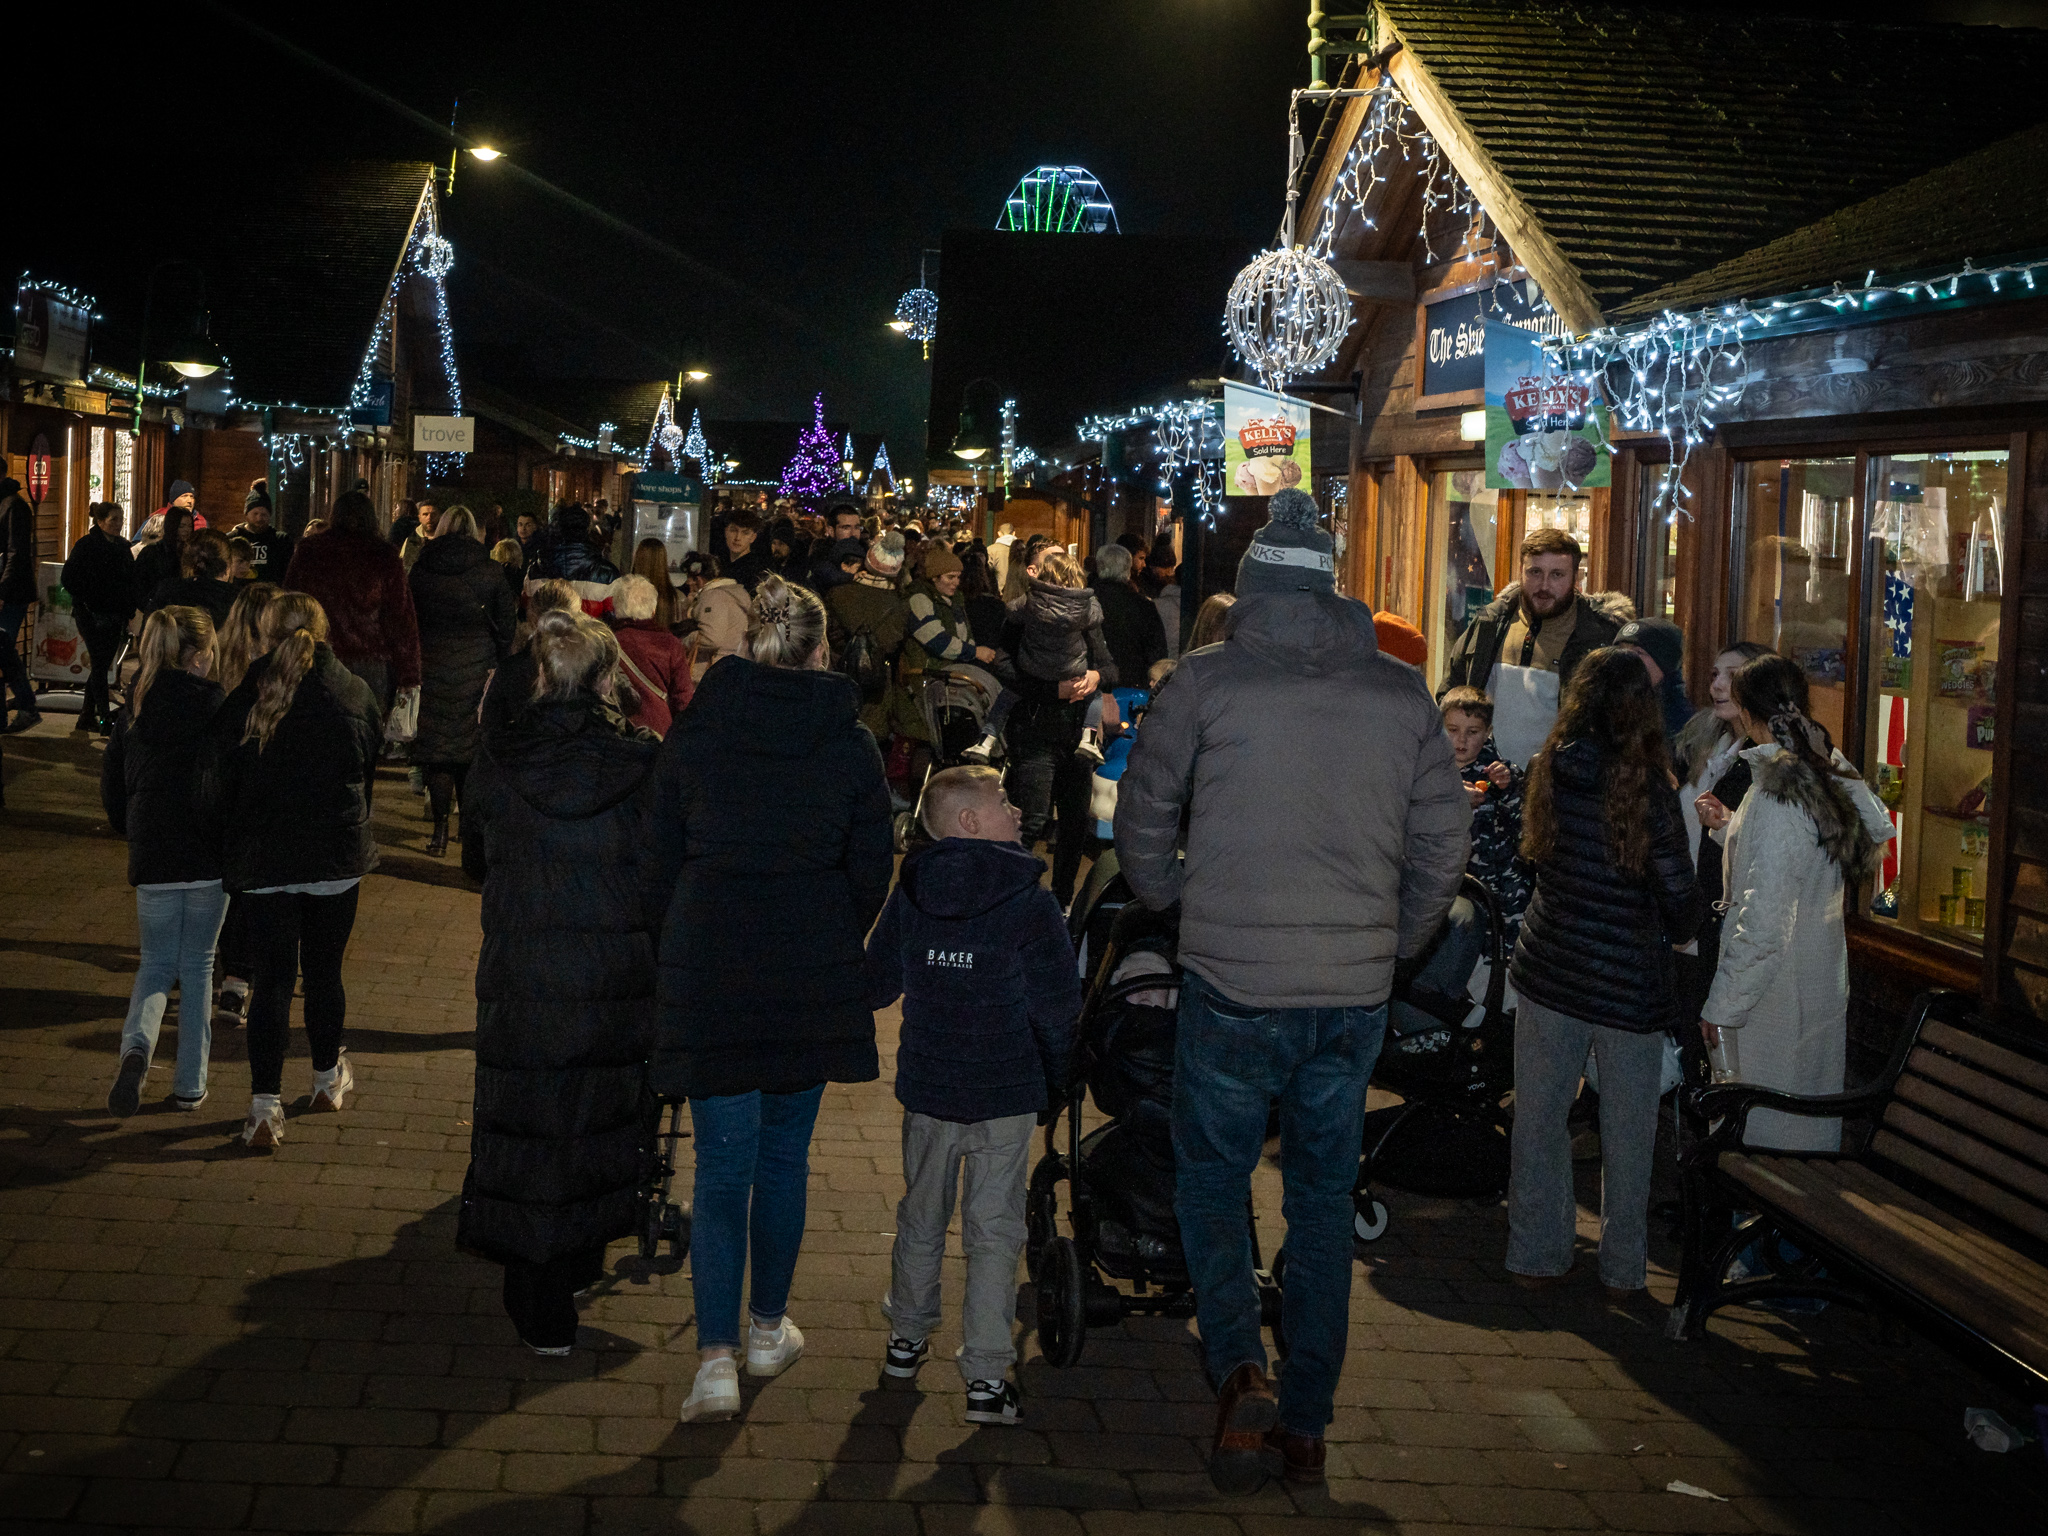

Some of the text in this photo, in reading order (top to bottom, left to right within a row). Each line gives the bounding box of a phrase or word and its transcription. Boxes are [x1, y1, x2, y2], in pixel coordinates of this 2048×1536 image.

[1429, 327, 1453, 368] The
[1455, 322, 1486, 361] Swe
[422, 426, 465, 442] trove
[1244, 427, 1292, 442] KELLY'S
[1253, 445, 1287, 456] Sold Here
[658, 485, 682, 494] shops
[928, 949, 973, 964] BAKER
